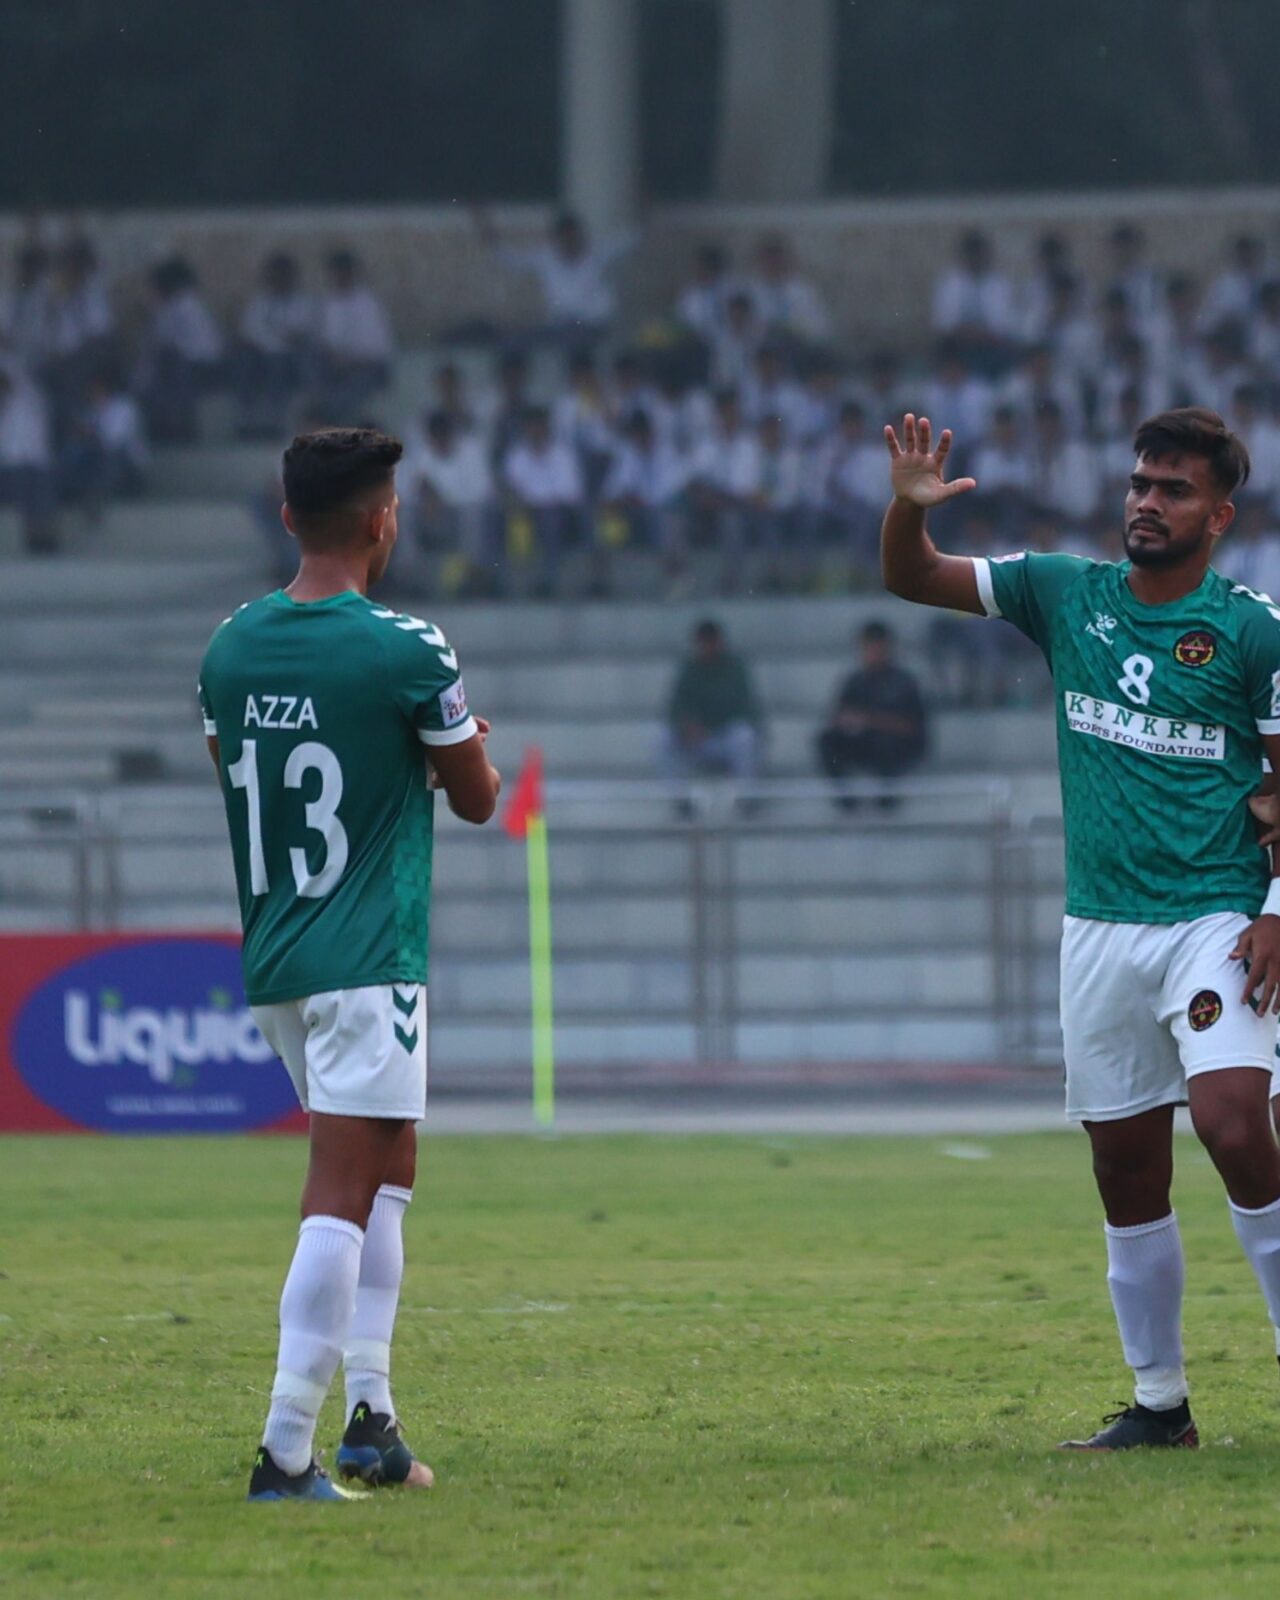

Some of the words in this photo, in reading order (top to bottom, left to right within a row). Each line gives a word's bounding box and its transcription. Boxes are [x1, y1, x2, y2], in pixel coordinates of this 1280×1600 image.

[1117, 653, 1154, 706] 8
[244, 694, 318, 730] AZZA
[1068, 694, 1218, 741] KENKRE
[1068, 718, 1110, 738] SPORTS
[1113, 731, 1217, 758] FOUNDATION
[228, 739, 349, 899] 13
